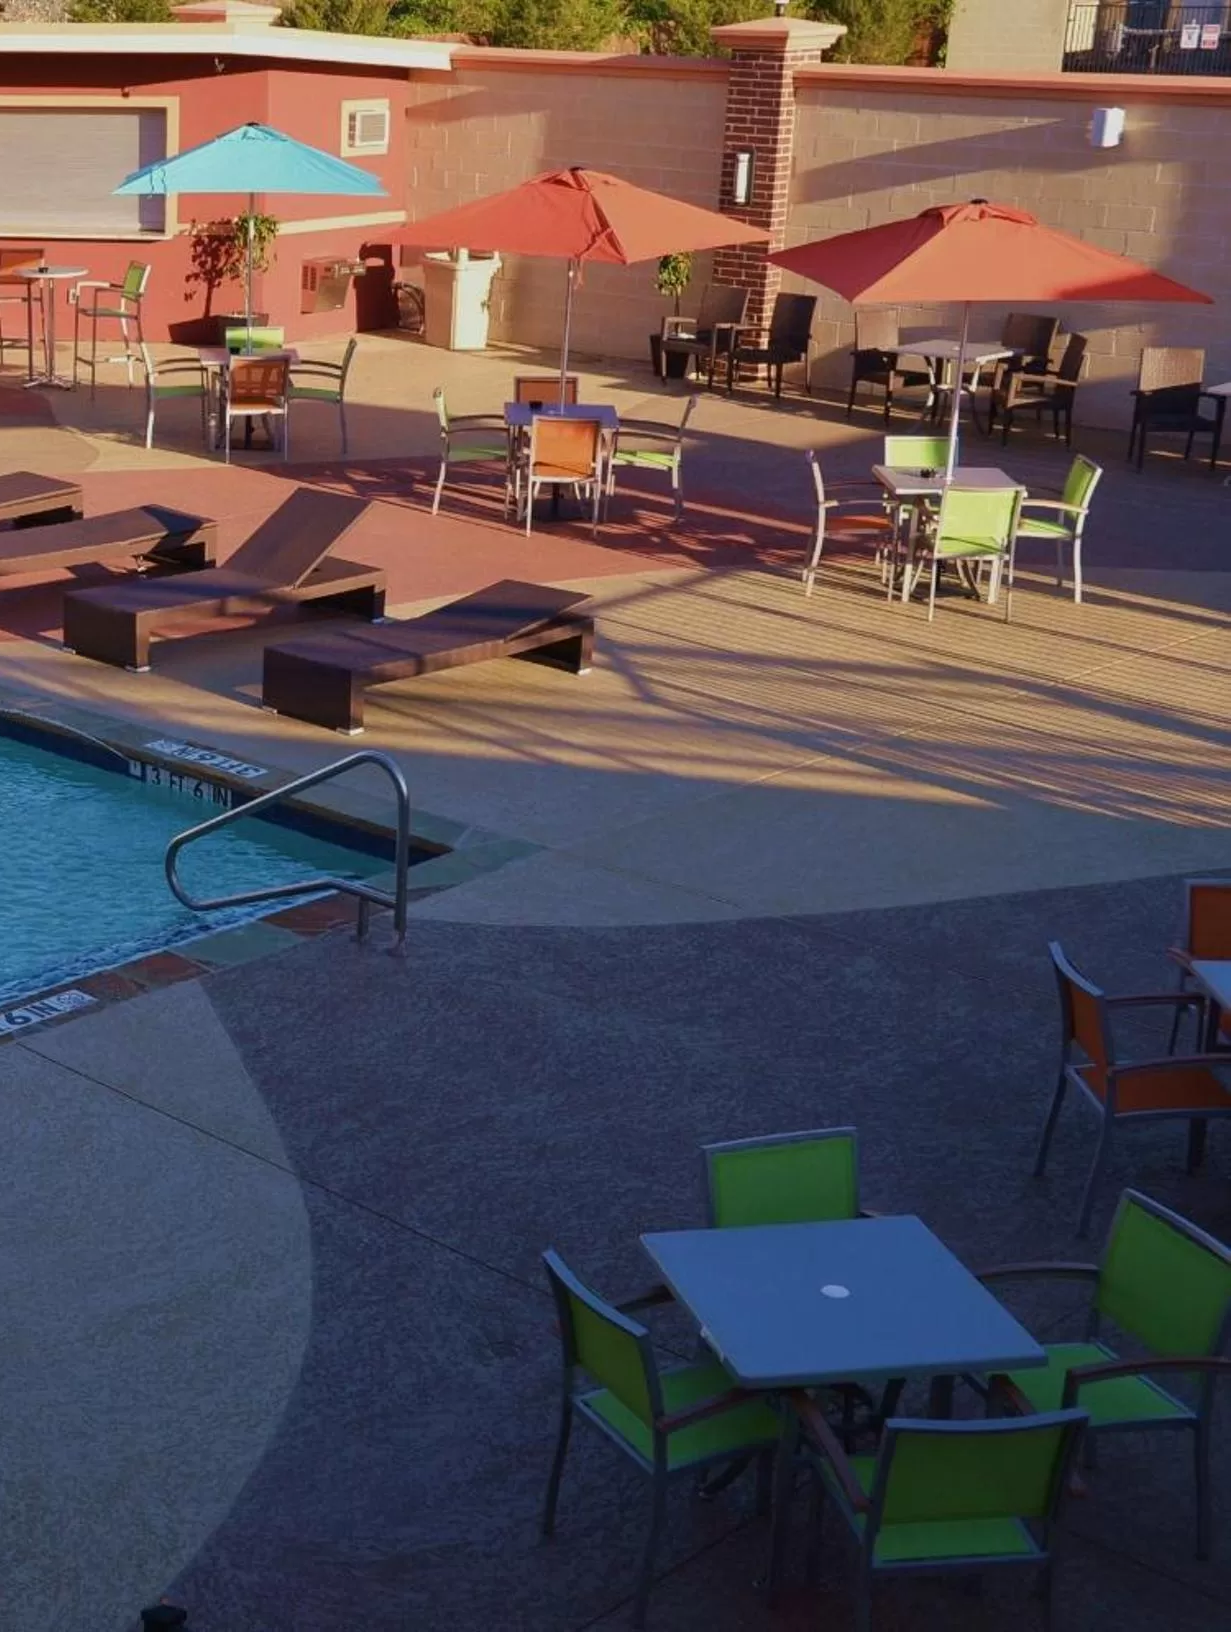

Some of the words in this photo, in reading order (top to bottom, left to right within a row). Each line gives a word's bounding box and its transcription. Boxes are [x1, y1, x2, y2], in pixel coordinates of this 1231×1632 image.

[151, 766, 162, 786] 3
[169, 771, 184, 793] FT
[193, 779, 204, 799] 6
[212, 785, 229, 807] IN
[3, 1011, 32, 1025] 6
[24, 1002, 61, 1017] IN
